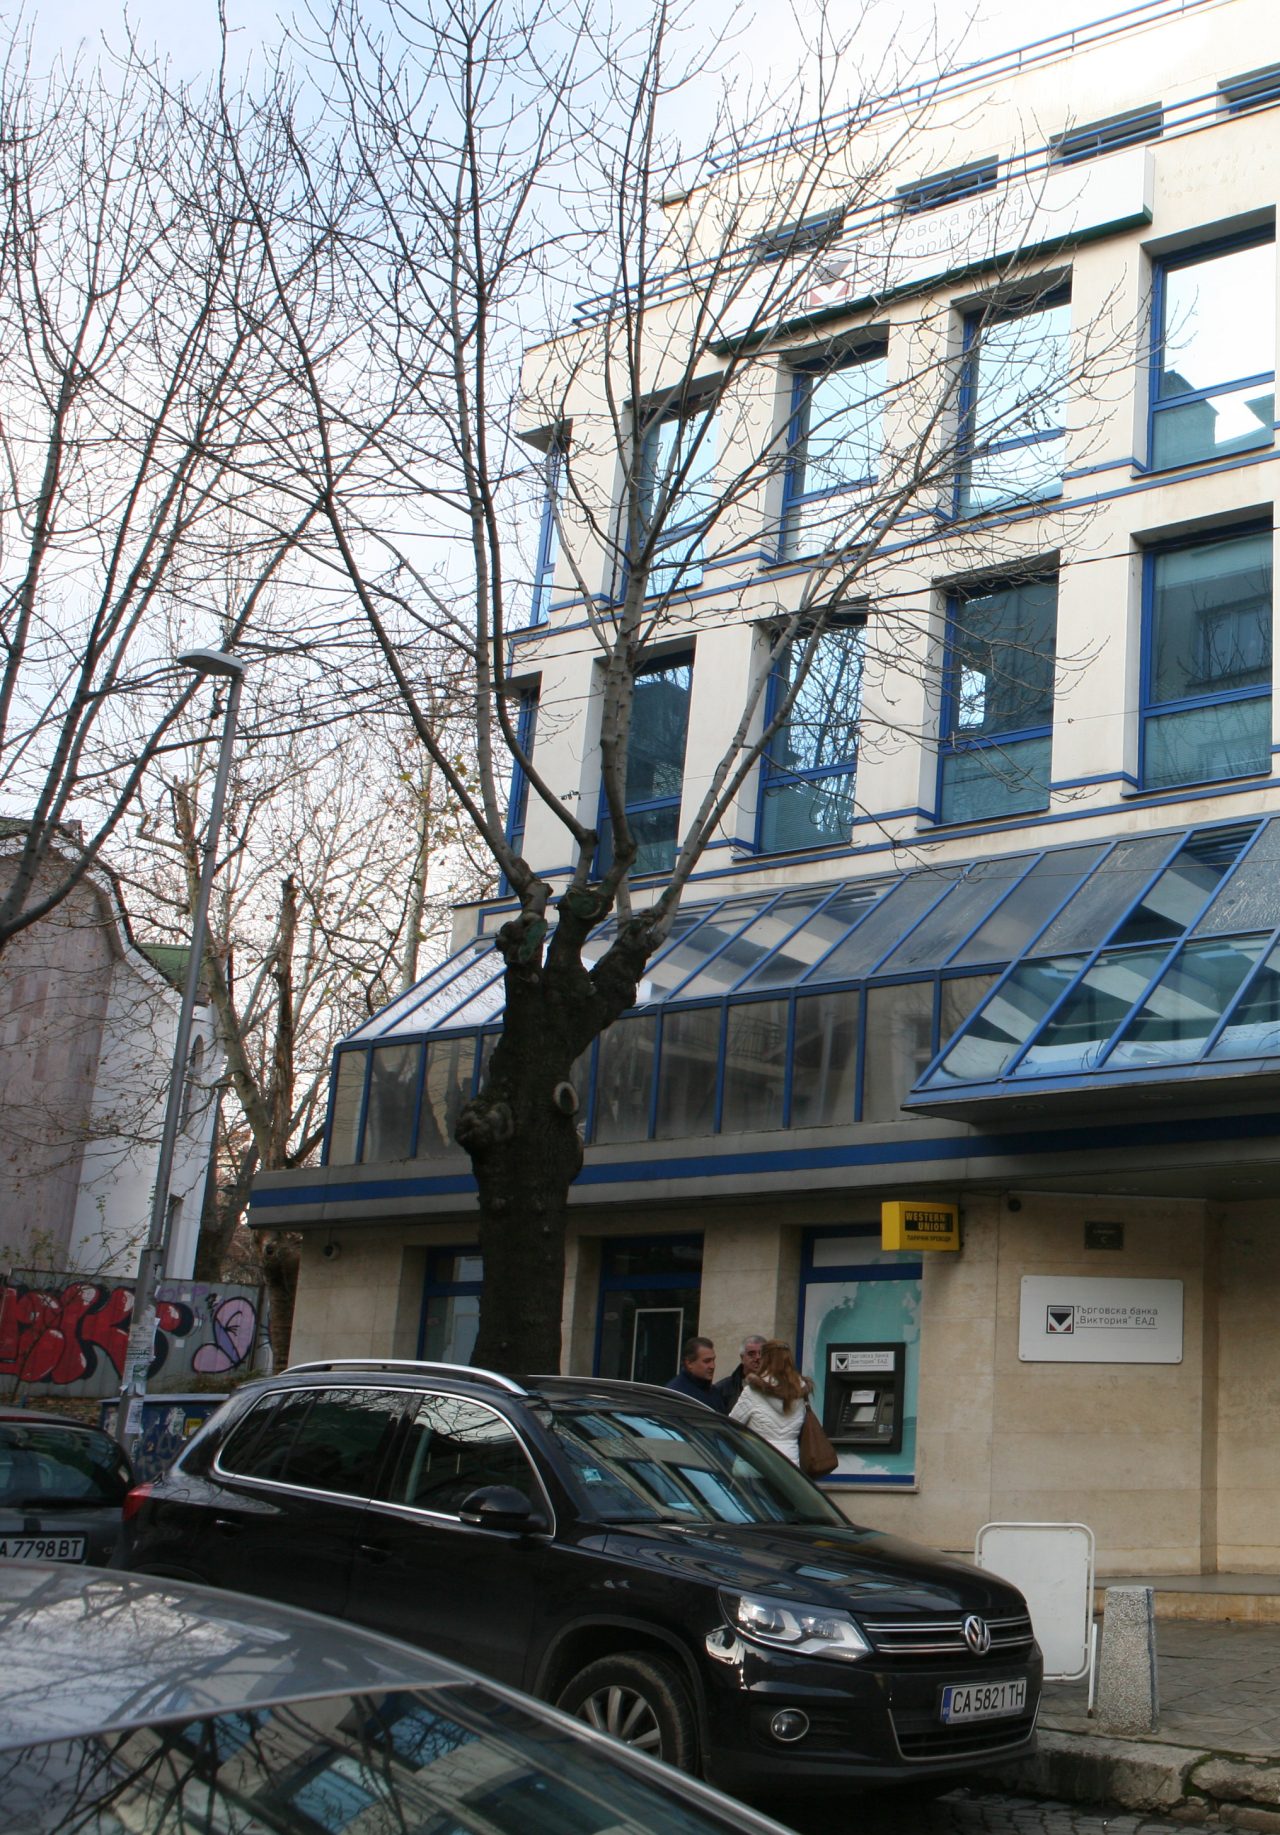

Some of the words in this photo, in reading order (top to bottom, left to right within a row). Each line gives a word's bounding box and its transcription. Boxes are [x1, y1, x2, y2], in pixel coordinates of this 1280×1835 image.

[906, 1213, 945, 1222] WESTERN
[918, 1222, 945, 1231] UNION
[1075, 1305, 1127, 1315] Търговска
[1130, 1306, 1158, 1316] банка
[1135, 1316, 1156, 1326] ЕАД
